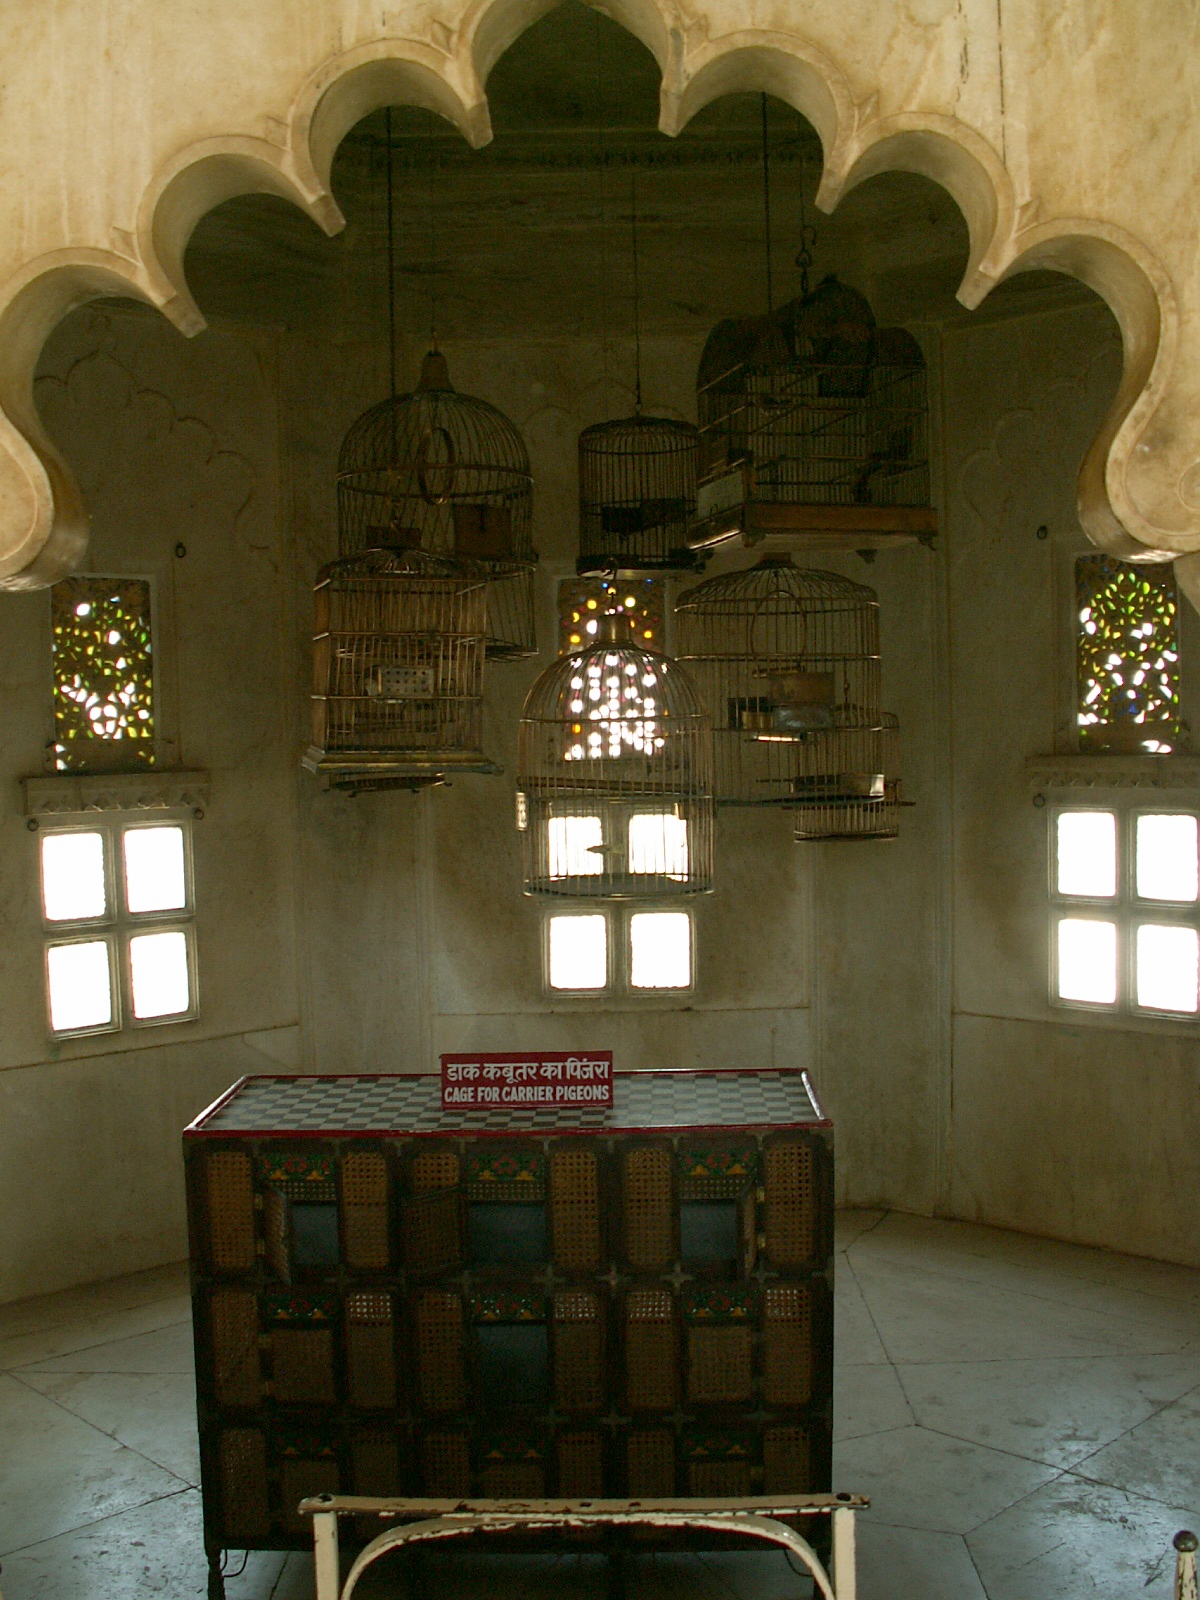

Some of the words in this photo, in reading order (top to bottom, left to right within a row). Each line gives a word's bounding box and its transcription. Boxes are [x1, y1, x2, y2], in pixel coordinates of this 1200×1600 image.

[446, 1063, 481, 1082] डाक
[482, 1062, 540, 1083] कबूतर
[540, 1061, 563, 1079] का
[444, 1086, 475, 1103] CAGE
[477, 1086, 500, 1102] FOR
[501, 1085, 554, 1102] CARRIER
[555, 1084, 610, 1101] PIGEONS
